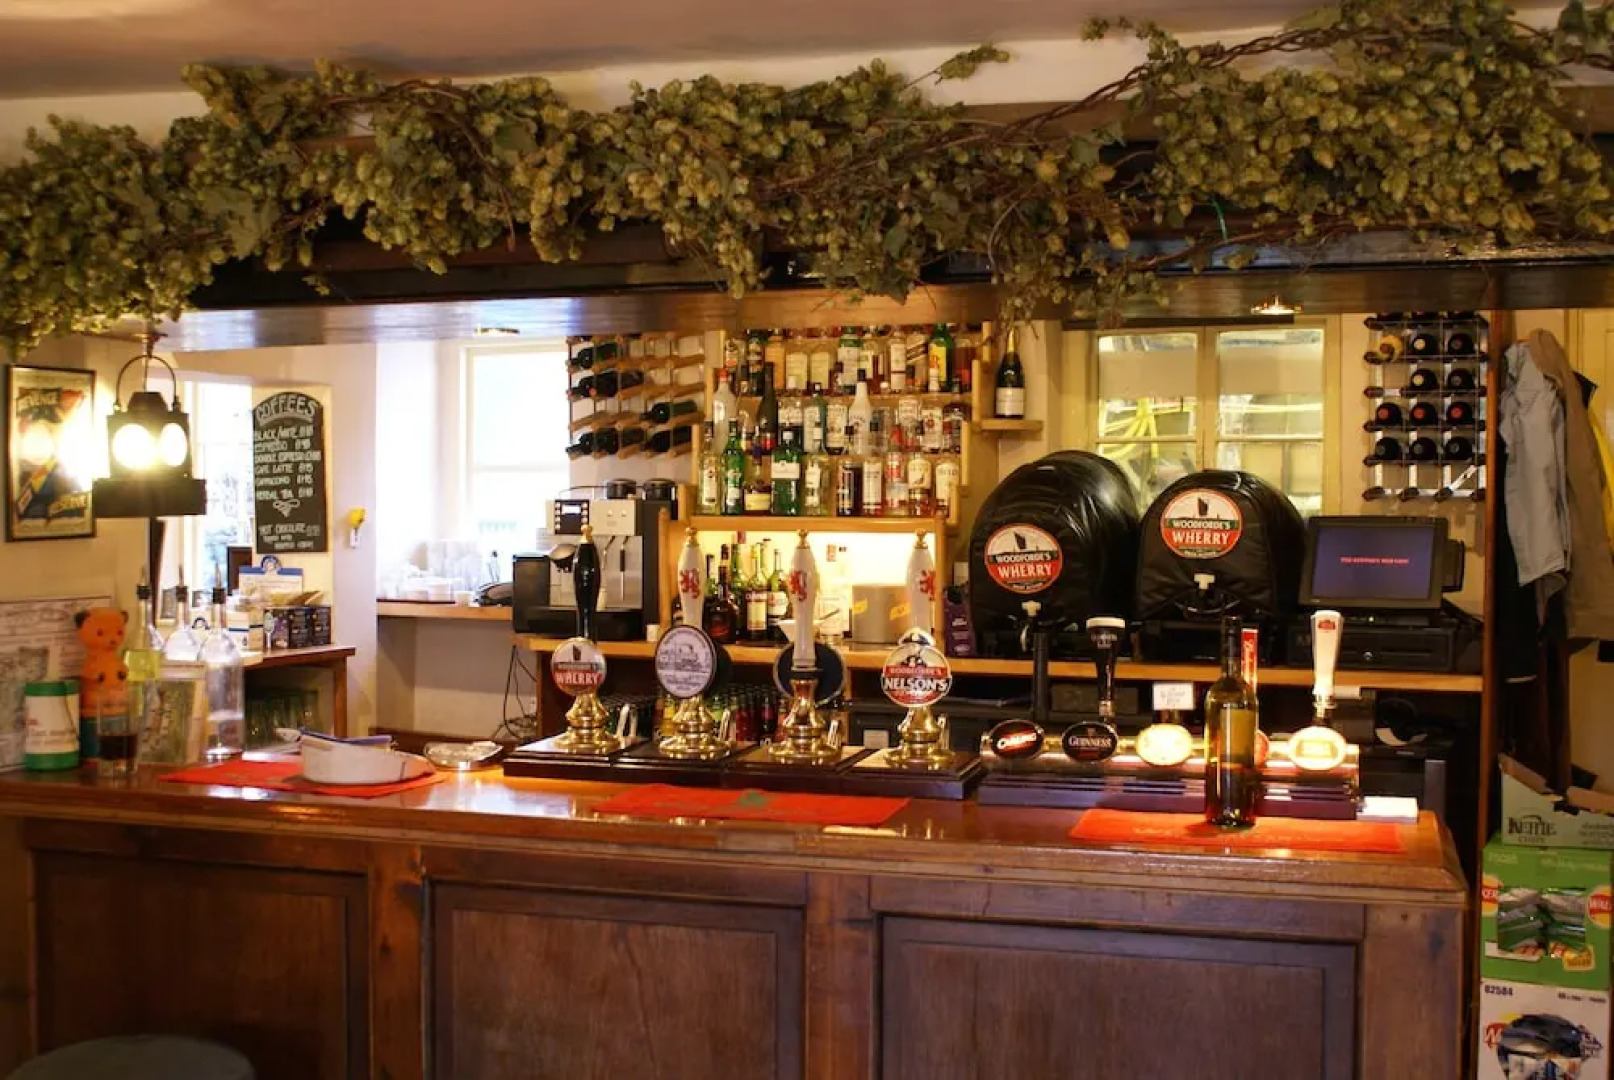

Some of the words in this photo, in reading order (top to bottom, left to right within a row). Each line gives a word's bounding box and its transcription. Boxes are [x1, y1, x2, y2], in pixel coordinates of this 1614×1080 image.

[256, 394, 318, 420] COFFEES
[1171, 530, 1231, 545] WHERRY
[997, 563, 1053, 579] WHERRY
[883, 677, 949, 692] NELSON'S
[1068, 735, 1112, 747] GUINNESS
